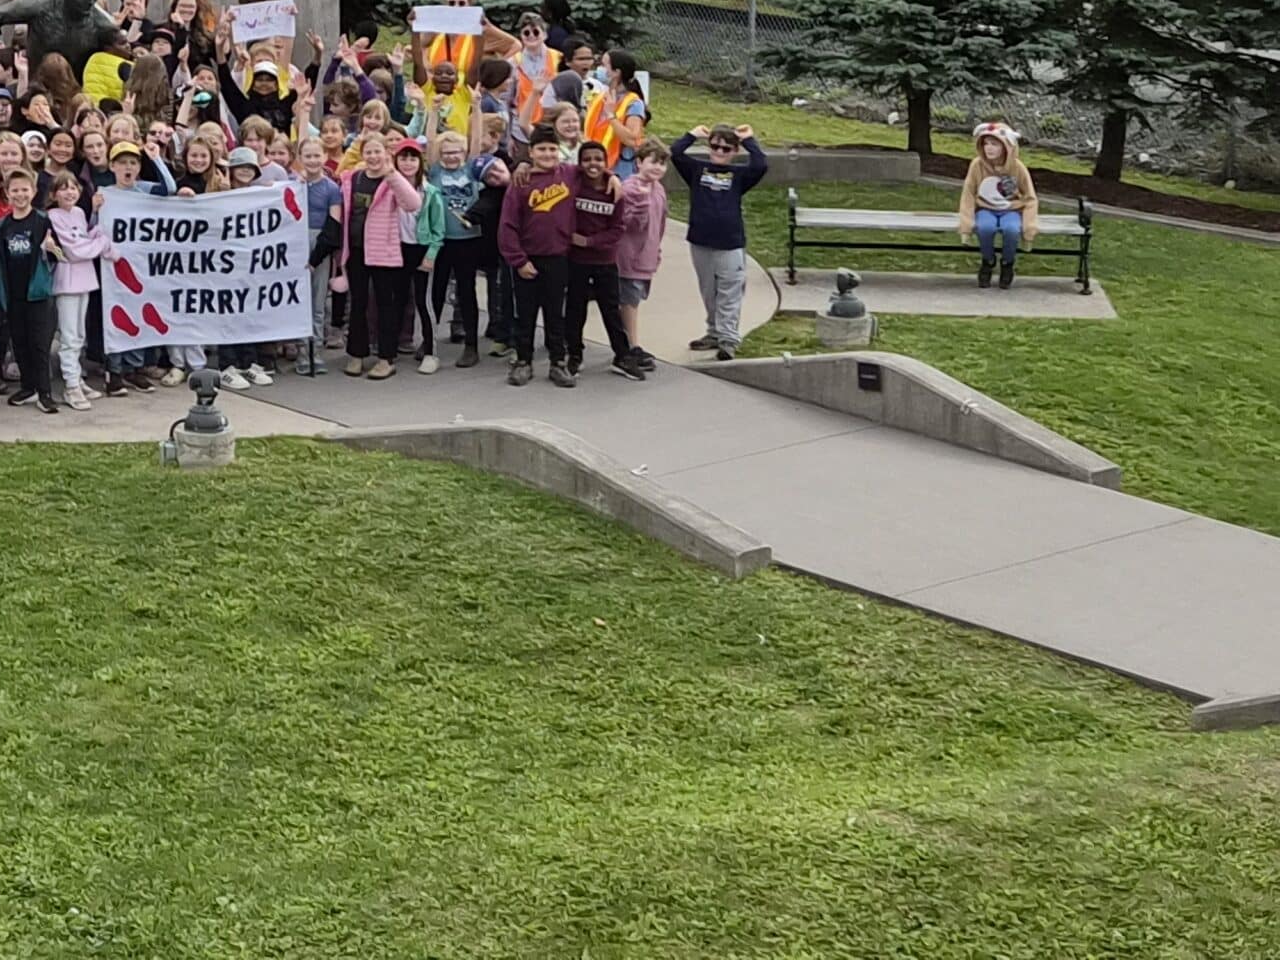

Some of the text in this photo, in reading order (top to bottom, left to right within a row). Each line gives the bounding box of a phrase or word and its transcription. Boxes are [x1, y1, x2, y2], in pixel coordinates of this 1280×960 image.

[113, 209, 281, 243] BISHOP FEILD
[148, 243, 288, 276] WALKS FOR
[171, 280, 299, 314] TERRY FOX
